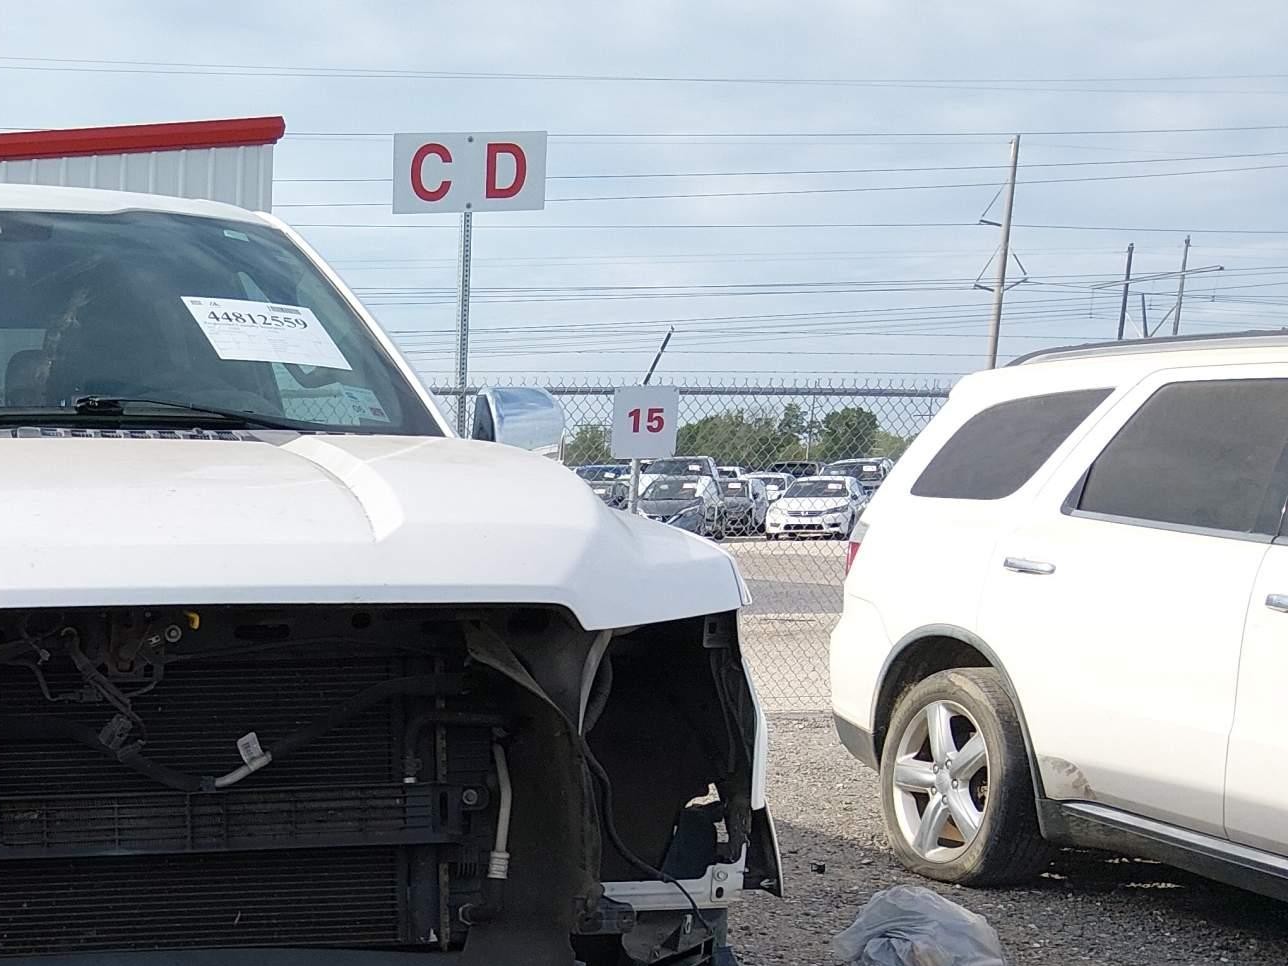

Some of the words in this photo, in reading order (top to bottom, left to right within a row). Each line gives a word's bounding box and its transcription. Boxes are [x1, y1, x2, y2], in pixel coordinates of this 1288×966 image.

[410, 144, 451, 202] C
[485, 144, 527, 199] D
[208, 311, 308, 329] 44812559
[629, 409, 664, 433] 15
